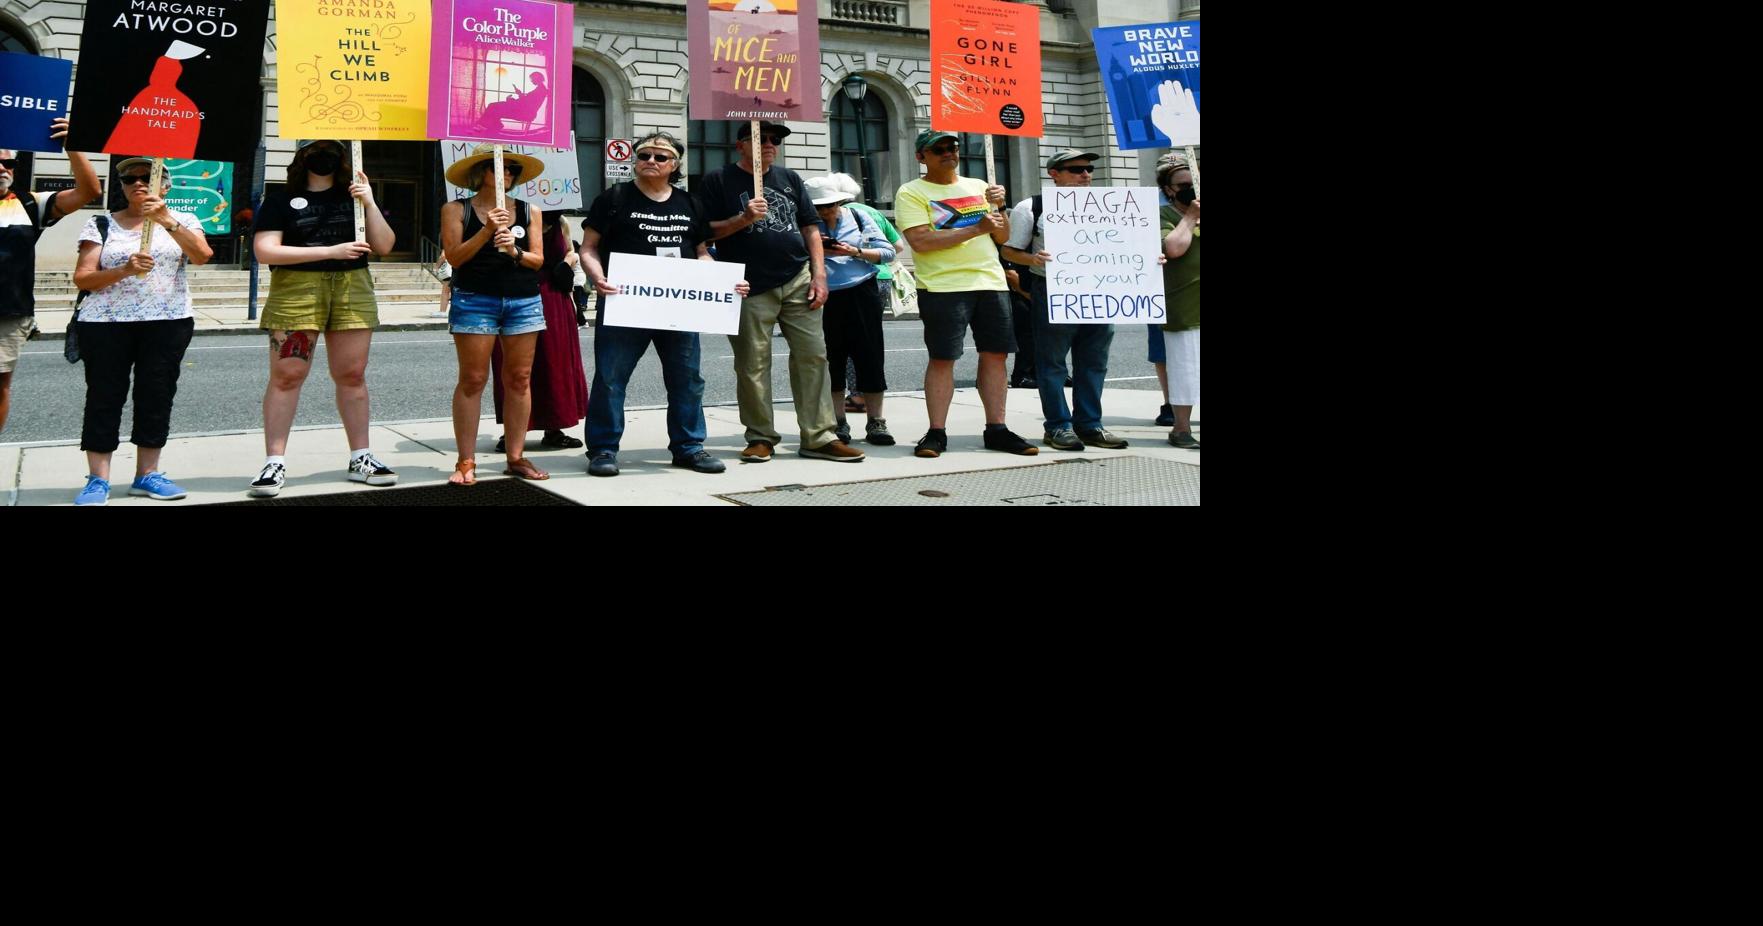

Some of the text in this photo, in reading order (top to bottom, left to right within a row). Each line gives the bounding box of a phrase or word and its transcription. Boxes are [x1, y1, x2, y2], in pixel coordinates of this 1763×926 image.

[131, 0, 226, 18] MARGARET
[318, 7, 396, 19] GORMAN
[494, 7, 521, 23] The
[113, 12, 238, 38] ATWOOD
[346, 28, 371, 36] THE
[463, 17, 548, 42] Color Purple
[728, 23, 741, 35] OF
[1124, 26, 1192, 42] BRAVE
[338, 39, 381, 51] HILL
[713, 36, 797, 64] MICE AND
[957, 37, 1018, 54] GONE
[1138, 39, 1184, 53] NEW
[343, 53, 375, 67] WE
[964, 54, 1013, 69] GIRL
[1129, 50, 1199, 66] WORLD
[1133, 62, 1200, 73] ALDOUS HUXLEY
[330, 70, 390, 82] CLIMB
[734, 65, 792, 93] MEN
[960, 73, 1017, 86] GILLIAN
[967, 86, 1011, 97] FLYNN
[0, 95, 58, 111] SIBLE
[153, 96, 177, 106] THE
[121, 106, 205, 120] HANDMAID'S
[726, 110, 789, 119] JOHN STEINBECK
[147, 119, 177, 130] TALE
[526, 178, 580, 198] BOOKS
[197, 197, 208, 205] of
[1056, 190, 1140, 214] MAGA
[630, 212, 668, 221] Student
[1046, 211, 1149, 228] extremists
[639, 223, 689, 232] Committee
[647, 234, 683, 243] (S.M.C.)
[1073, 229, 1125, 245] are
[1053, 269, 1148, 289] for your
[633, 285, 733, 304] INDIVISIBLE
[1050, 294, 1164, 320] FREEDOMS
